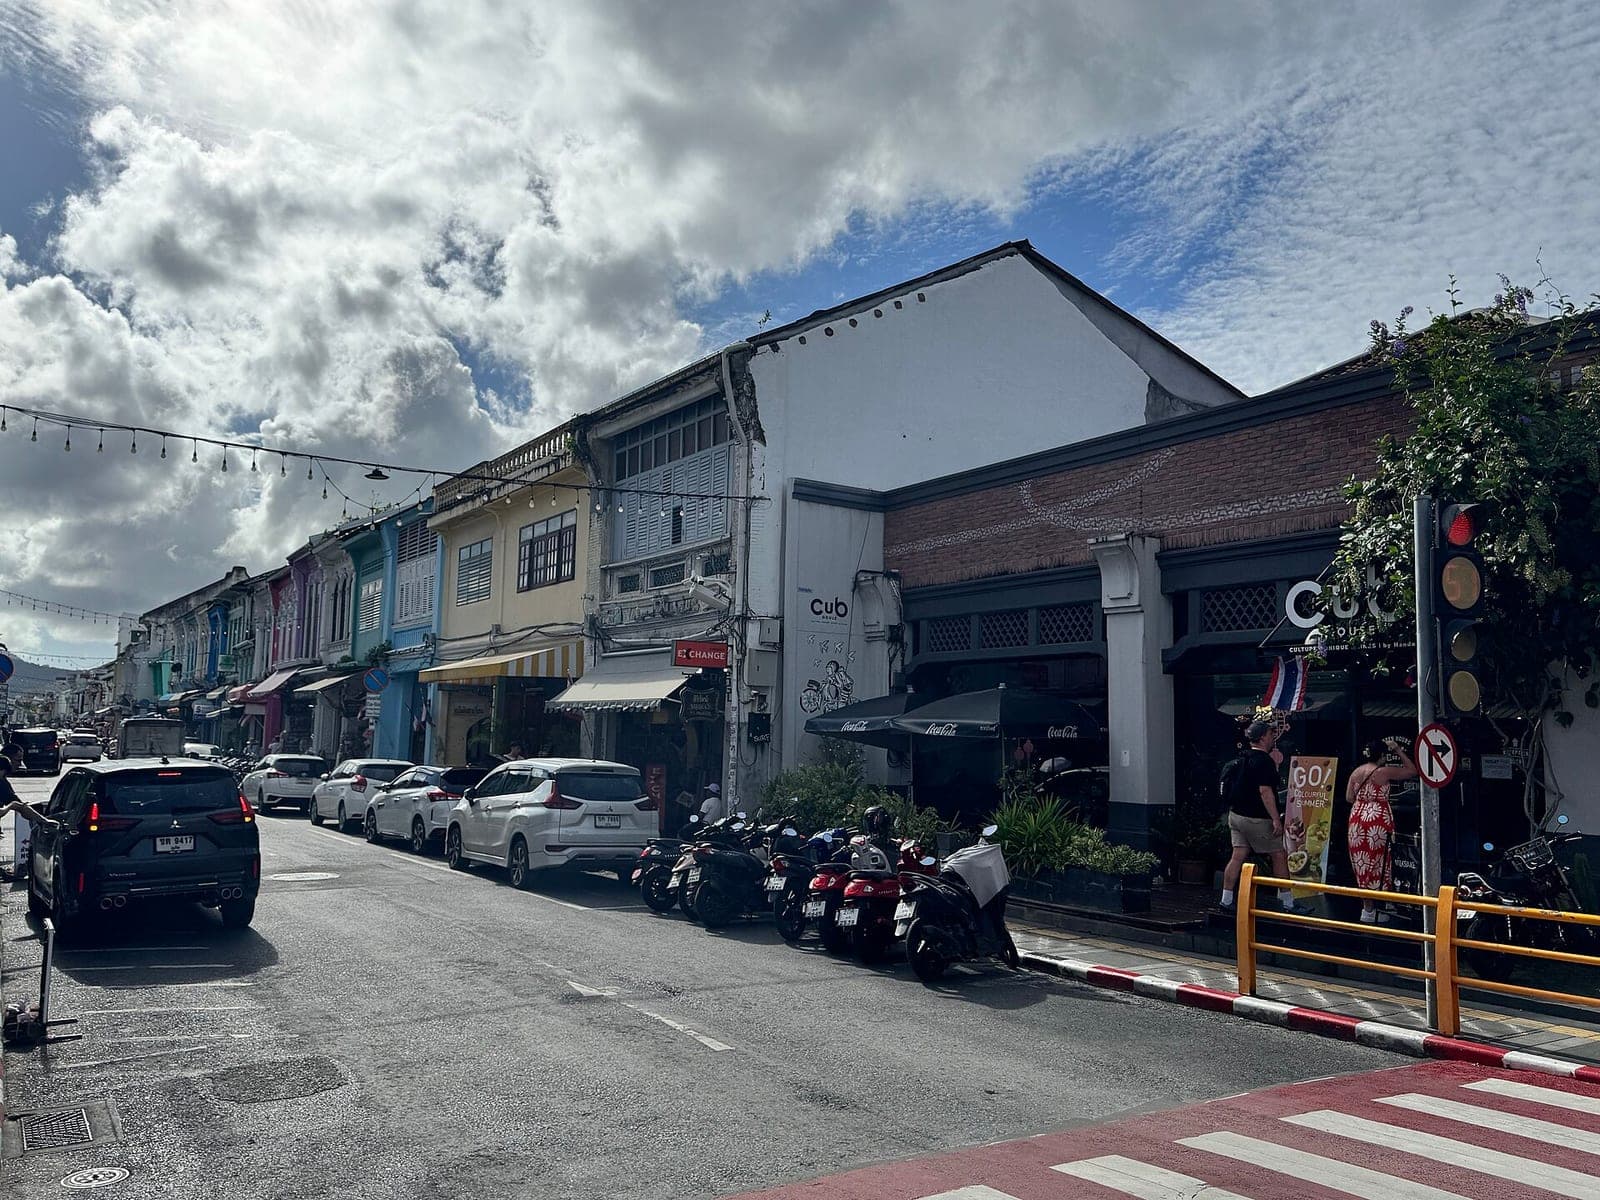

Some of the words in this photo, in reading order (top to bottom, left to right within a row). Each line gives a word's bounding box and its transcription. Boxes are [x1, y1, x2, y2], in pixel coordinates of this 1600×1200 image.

[810, 597, 848, 618] Cub
[677, 649, 726, 661] EXCHANGE
[1293, 765, 1332, 789] GO!
